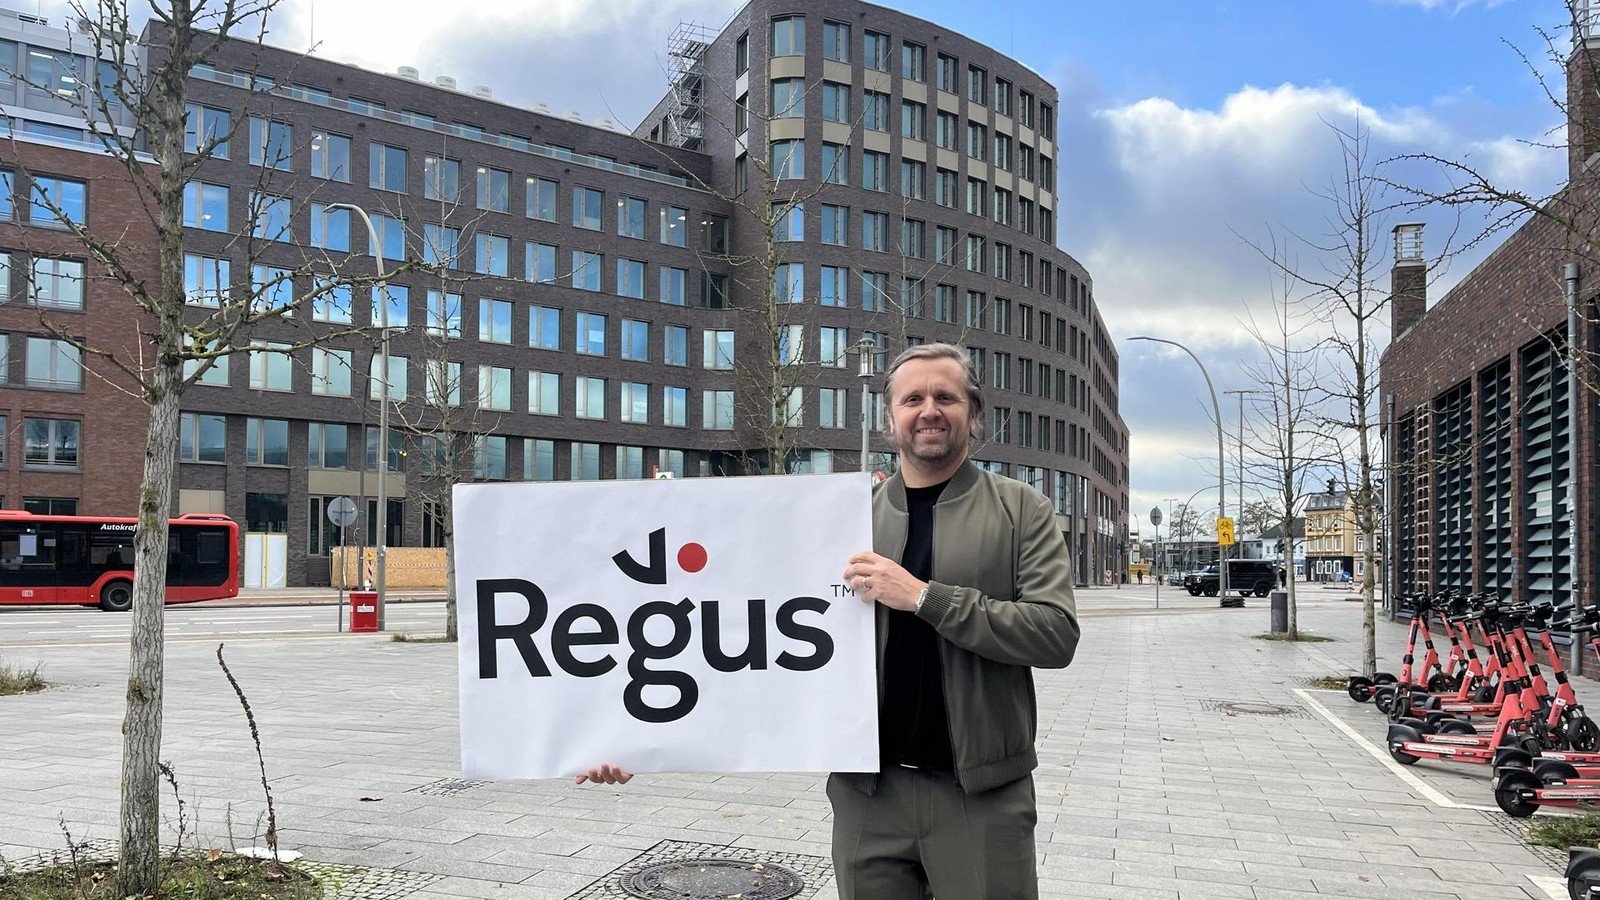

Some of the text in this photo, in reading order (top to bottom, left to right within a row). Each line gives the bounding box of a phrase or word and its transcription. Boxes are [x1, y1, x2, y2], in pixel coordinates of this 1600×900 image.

[100, 523, 139, 532] Autokraf
[477, 579, 855, 723] Regus TM
